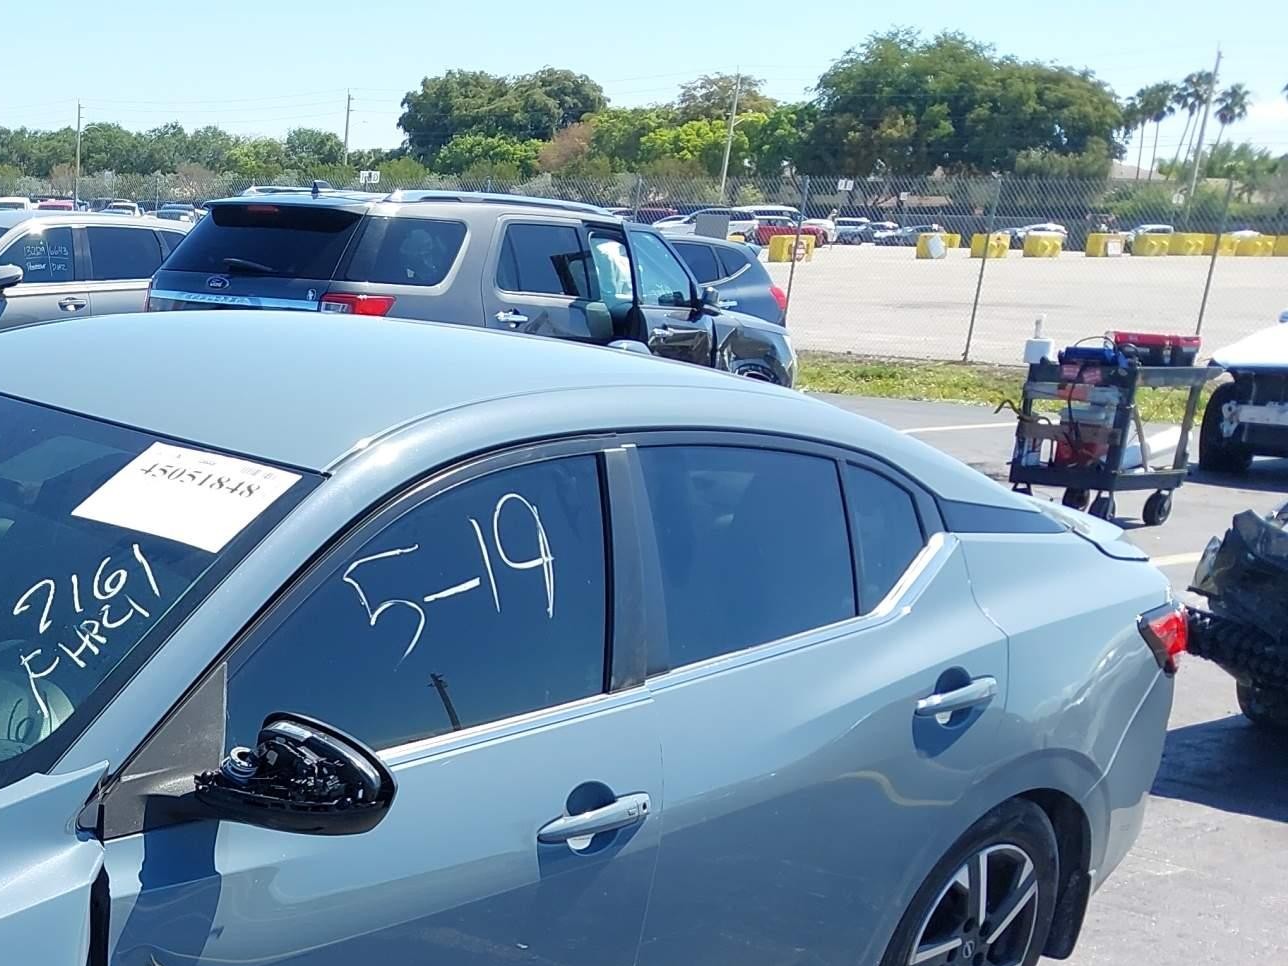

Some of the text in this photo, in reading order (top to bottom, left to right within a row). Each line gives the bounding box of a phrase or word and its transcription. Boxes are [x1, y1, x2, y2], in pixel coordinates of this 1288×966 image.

[140, 462, 261, 498] 45051848
[13, 543, 160, 634] 2161
[343, 493, 554, 668] 5-19
